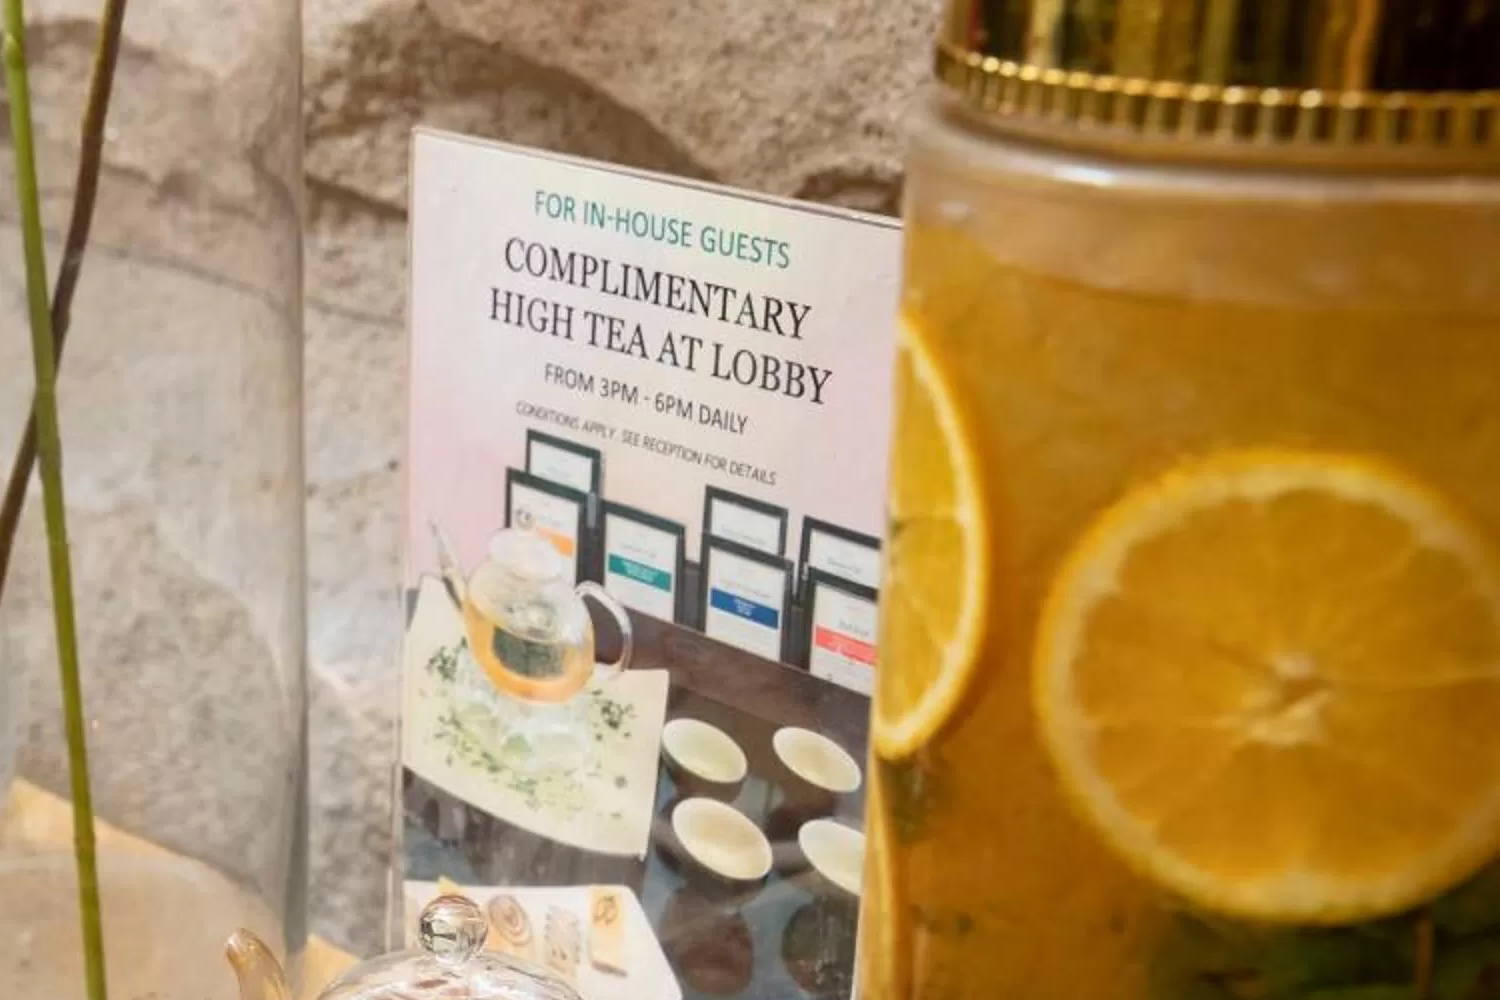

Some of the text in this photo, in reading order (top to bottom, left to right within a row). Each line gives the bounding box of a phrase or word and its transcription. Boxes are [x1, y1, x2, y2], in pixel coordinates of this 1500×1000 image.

[535, 190, 791, 269] FOR IN-HOUSE GUESTS
[505, 237, 812, 340] COMPLIMENTARY
[489, 287, 833, 404] HIGH TEA AT LOBBY
[544, 363, 595, 395] FROM
[600, 378, 638, 405] 3PM
[654, 392, 693, 421] 6PM
[698, 404, 749, 436] DAILY
[516, 402, 579, 430] CONDITIONS
[621, 429, 641, 447] SEE
[642, 434, 702, 465] RECEPTION
[705, 453, 729, 473] FOR
[729, 460, 778, 486] DETAILS
